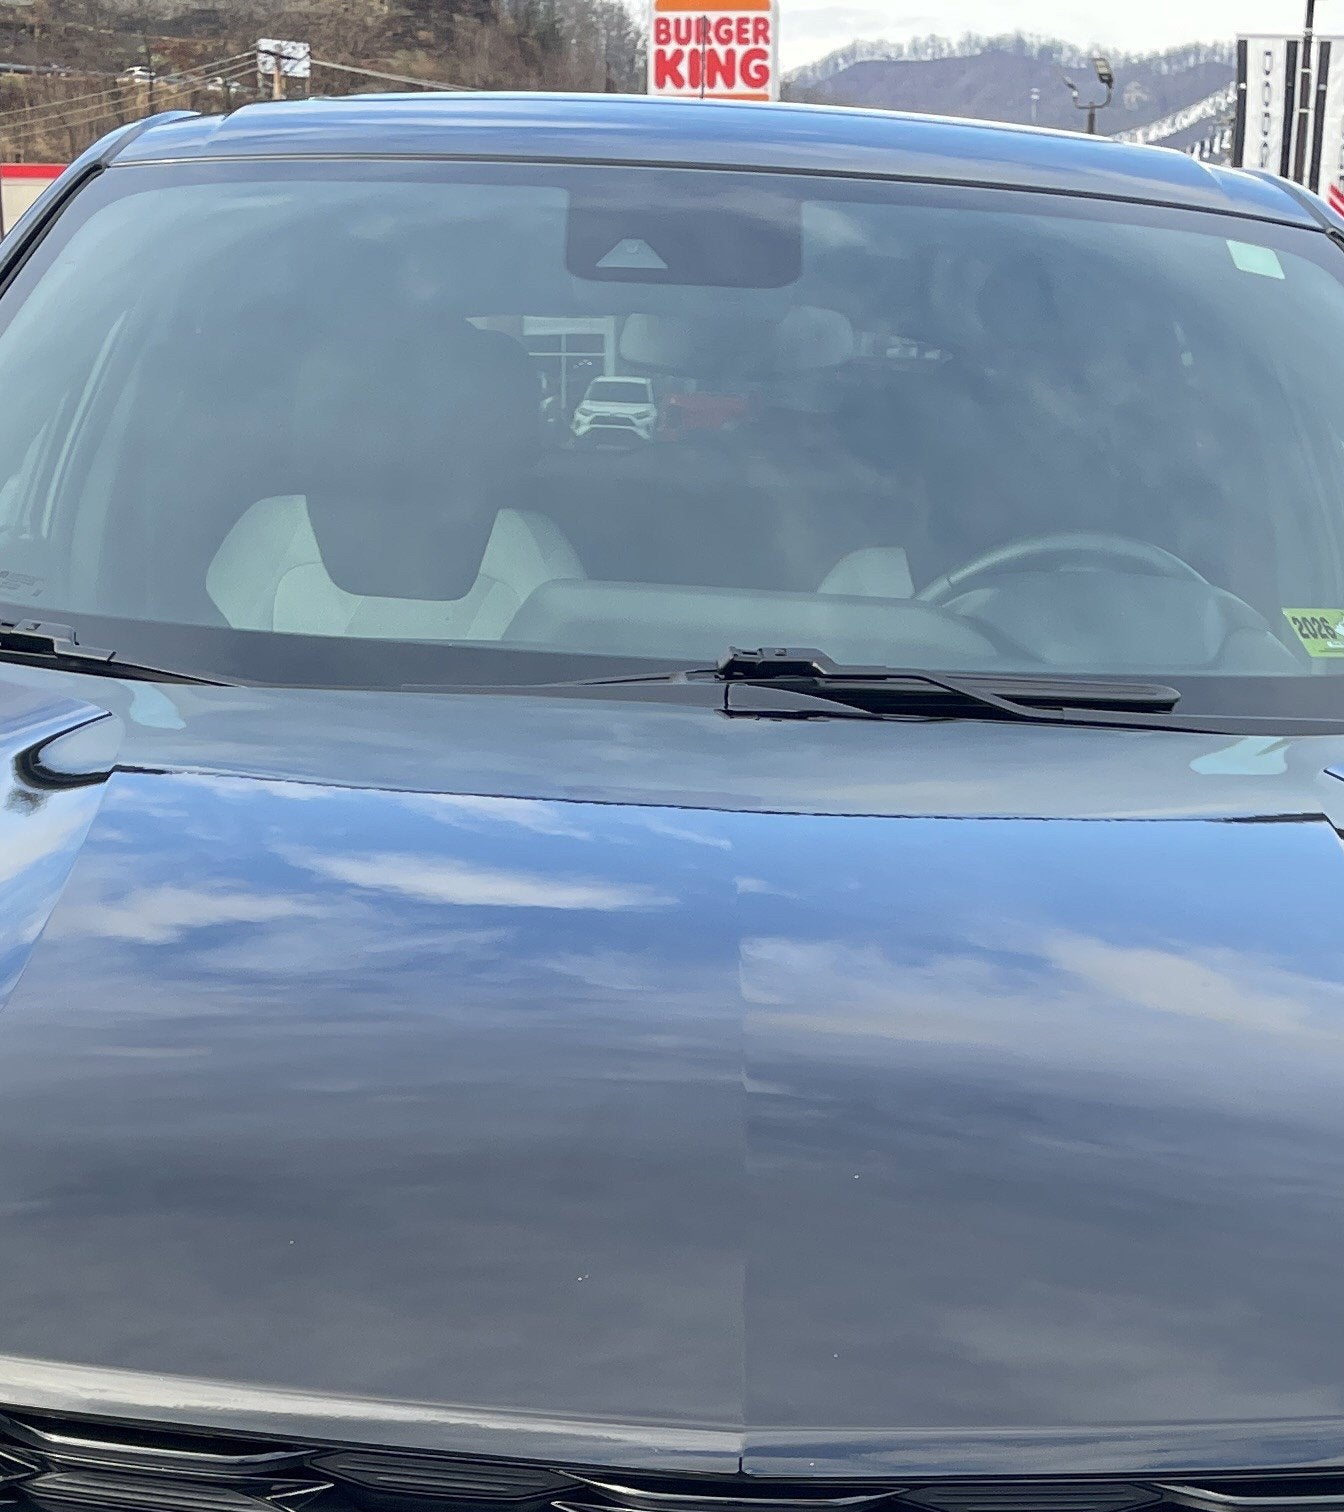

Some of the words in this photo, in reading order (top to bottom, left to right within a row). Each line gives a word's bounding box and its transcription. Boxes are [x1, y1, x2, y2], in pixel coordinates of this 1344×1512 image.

[654, 16, 770, 46] BURGER
[654, 47, 770, 90] KING
[1291, 615, 1338, 640] 2026
